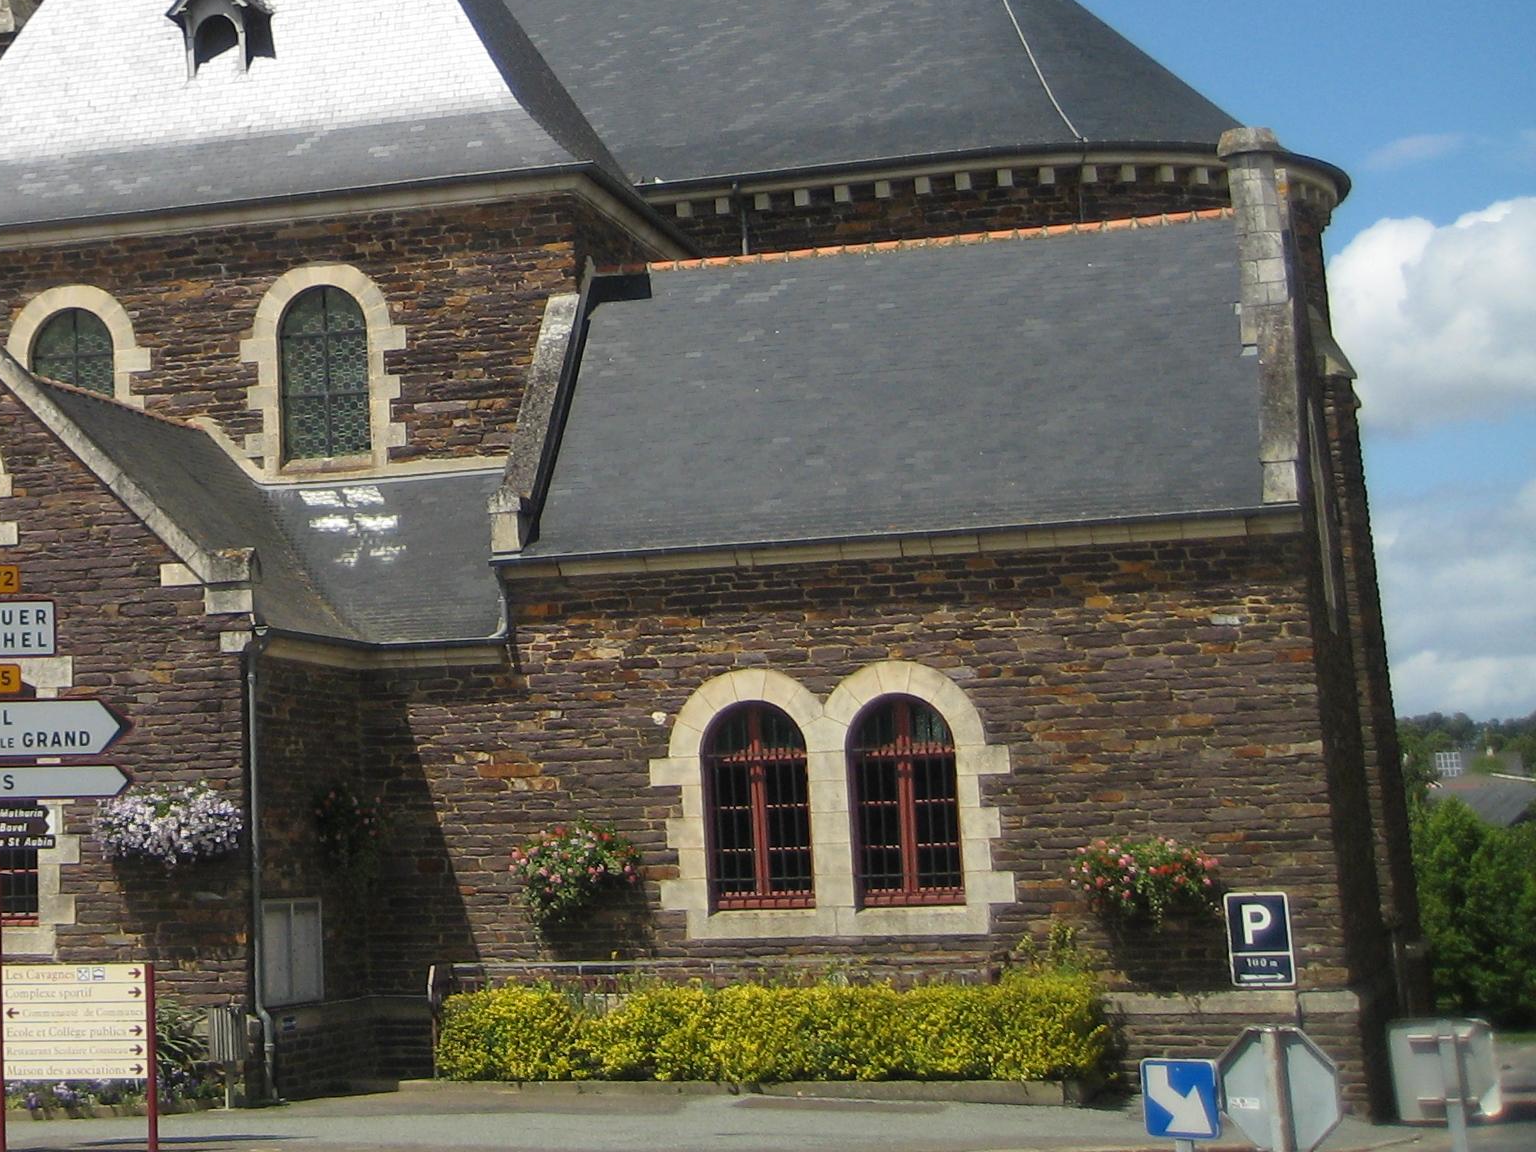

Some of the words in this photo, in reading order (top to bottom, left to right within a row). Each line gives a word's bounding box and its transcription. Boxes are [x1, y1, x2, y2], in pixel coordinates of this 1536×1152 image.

[0, 737, 14, 749] LE
[21, 730, 92, 748] GRAND
[0, 808, 44, 819] Mathurin
[0, 823, 28, 833] Bovel
[7, 837, 20, 848] St
[23, 837, 54, 847] Aubin
[1241, 904, 1271, 945] P
[1246, 957, 1267, 968] 100
[5, 969, 23, 980] Les
[5, 987, 56, 1000] Complexe
[58, 987, 93, 1000] sportif
[36, 1027, 46, 1037] et
[7, 1065, 44, 1077] Maison
[48, 1065, 64, 1076] des
[66, 1064, 127, 1076] associations
